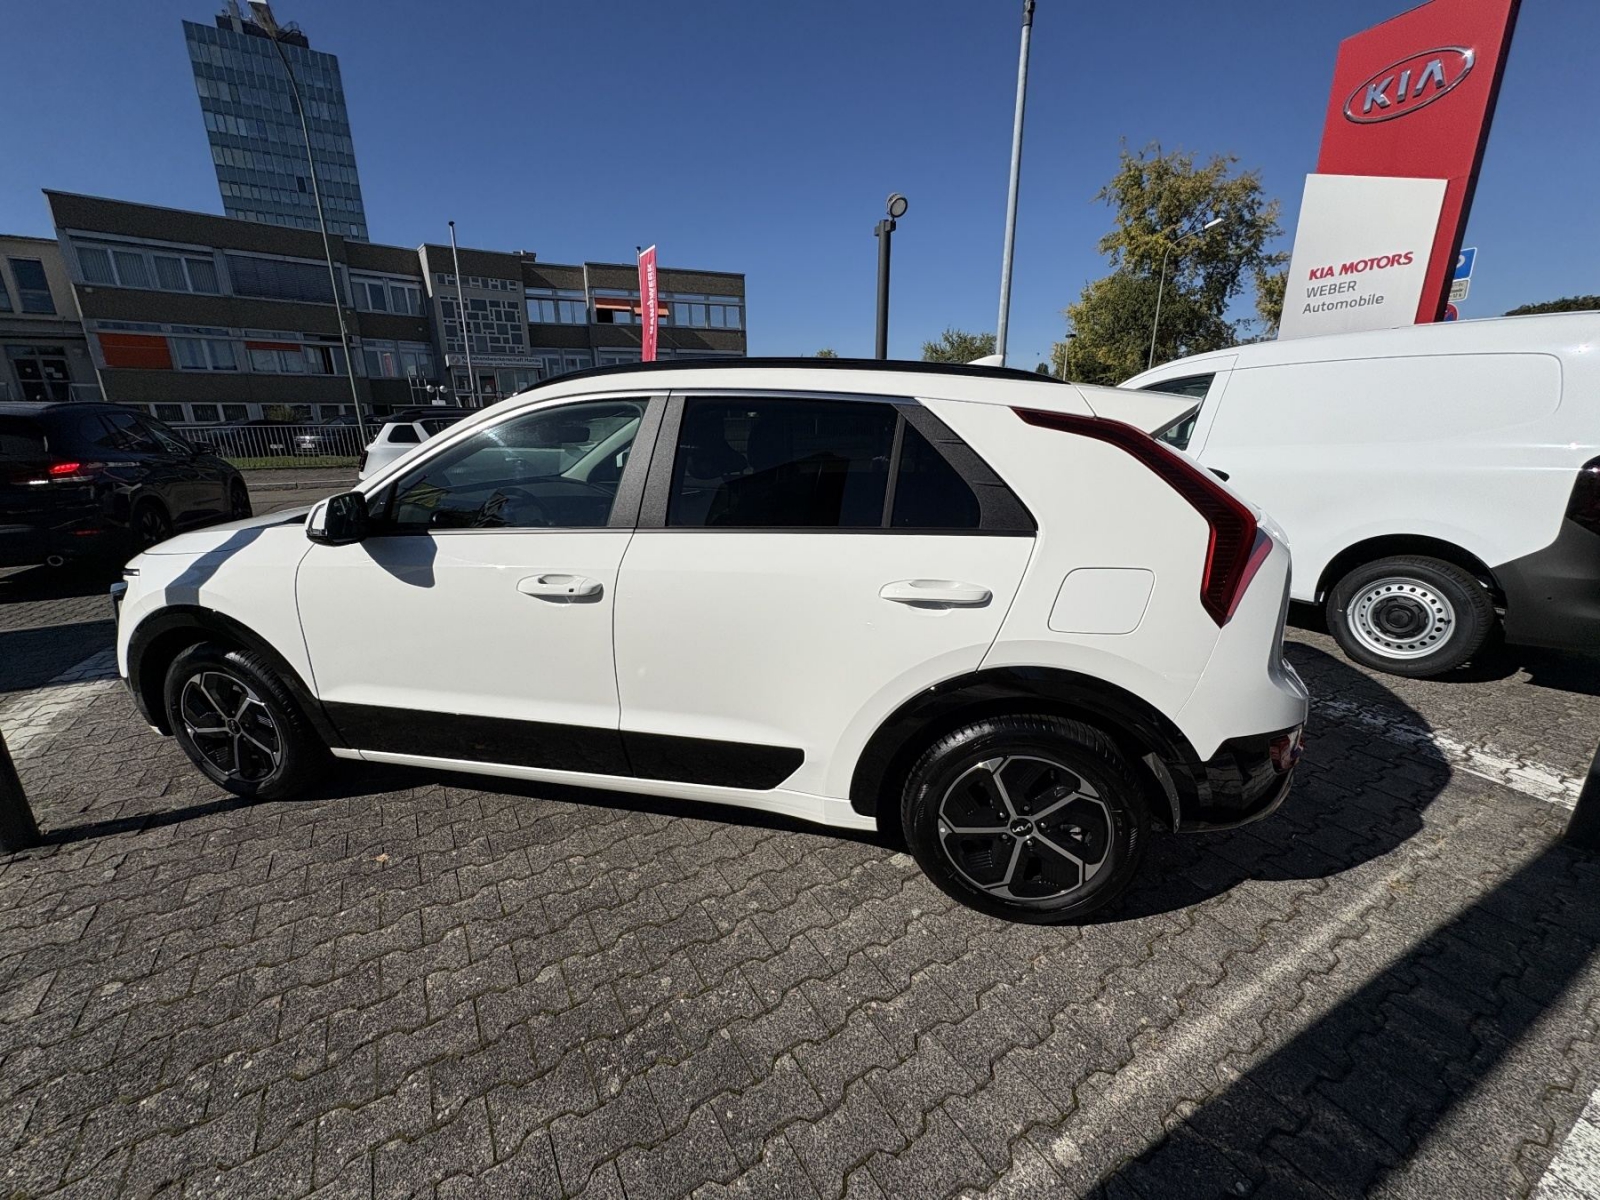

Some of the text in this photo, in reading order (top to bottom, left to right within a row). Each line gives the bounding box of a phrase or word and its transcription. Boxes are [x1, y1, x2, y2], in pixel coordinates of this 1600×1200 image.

[1363, 59, 1446, 114] KIA
[1308, 251, 1414, 281] KIA MOTORS
[1306, 280, 1357, 299] WEBER
[1302, 293, 1384, 314] Automobile
